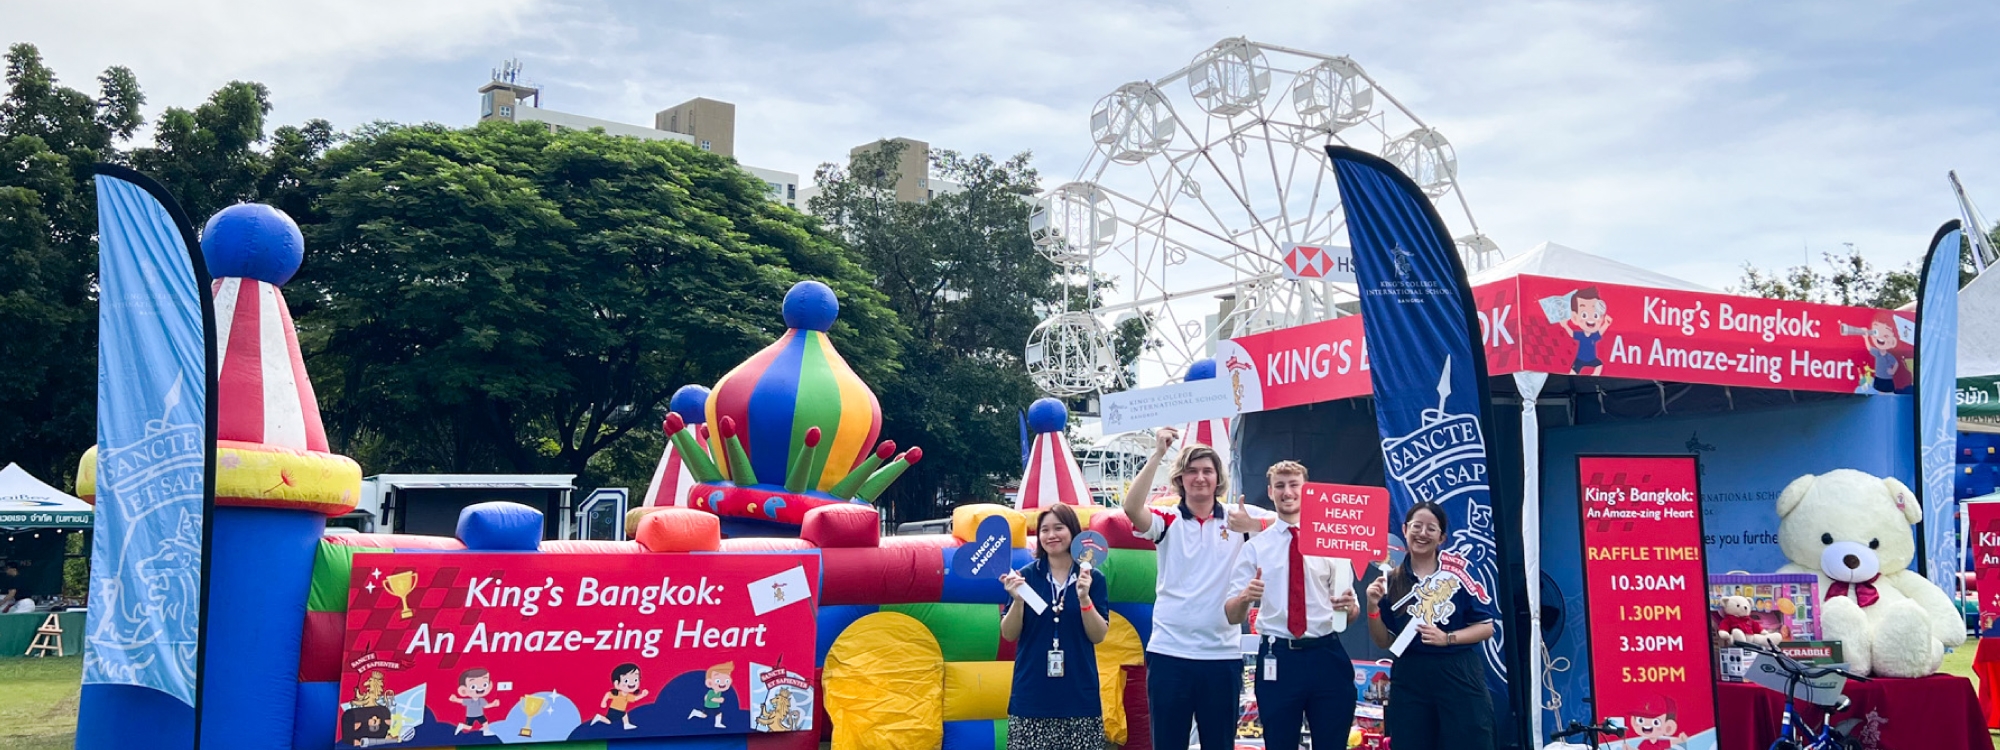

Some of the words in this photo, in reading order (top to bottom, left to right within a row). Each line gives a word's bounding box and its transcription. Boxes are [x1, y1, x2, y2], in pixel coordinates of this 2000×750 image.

[1338, 256, 1356, 273] HS
[1366, 288, 1424, 296] INTERNATIONAL
[1643, 296, 1710, 336] King’s
[1719, 303, 1821, 342] Bangkok:
[1267, 339, 1352, 387] KING’S
[1609, 335, 1641, 365] An
[1648, 338, 1782, 383] Amaze-zing
[1790, 349, 1855, 380] Heart
[1130, 399, 1193, 413] INTERNATIONAL
[1195, 393, 1228, 404] SCHOOL
[1157, 391, 1193, 402] COLLEGE
[1955, 386, 1989, 405] ริษัท
[1390, 421, 1477, 472] SANCTE
[106, 431, 197, 481] SANCTE
[126, 484, 156, 512] ET
[161, 472, 203, 496] SAP
[1416, 473, 1446, 504] ET
[1444, 463, 1487, 486] SAP
[1331, 493, 1371, 505] GREAT
[1585, 487, 1626, 506] King’s
[1630, 487, 1694, 506] Bangkok:
[1756, 491, 1781, 501] SCHO
[1325, 507, 1364, 520] HEART
[1587, 507, 1601, 518] An
[1602, 507, 1662, 521] Amaze-zing
[1664, 507, 1695, 518] Heart
[1312, 521, 1348, 535] TAKES
[1349, 524, 1376, 537] YOU
[1316, 537, 1371, 552] FURTHER.
[1719, 534, 1740, 549] you
[1743, 529, 1779, 545] furthe
[970, 534, 995, 563] KING'S
[971, 534, 1007, 576] BANGKOK
[1588, 546, 1650, 561] RAFFLE
[1653, 546, 1700, 561] TIME!
[1982, 552, 1999, 565] An
[1610, 574, 1686, 591] 10.30AM
[464, 576, 564, 616] King’s
[576, 576, 725, 614] Bangkok:
[1619, 605, 1682, 621] 1.30PM
[405, 623, 455, 654] An
[463, 622, 662, 658] Amaze-zing
[674, 619, 767, 649] Heart
[1619, 635, 1684, 652] 3.30PM
[1782, 647, 1831, 658] SCRABBLE
[1622, 666, 1686, 683] 5.30PM
